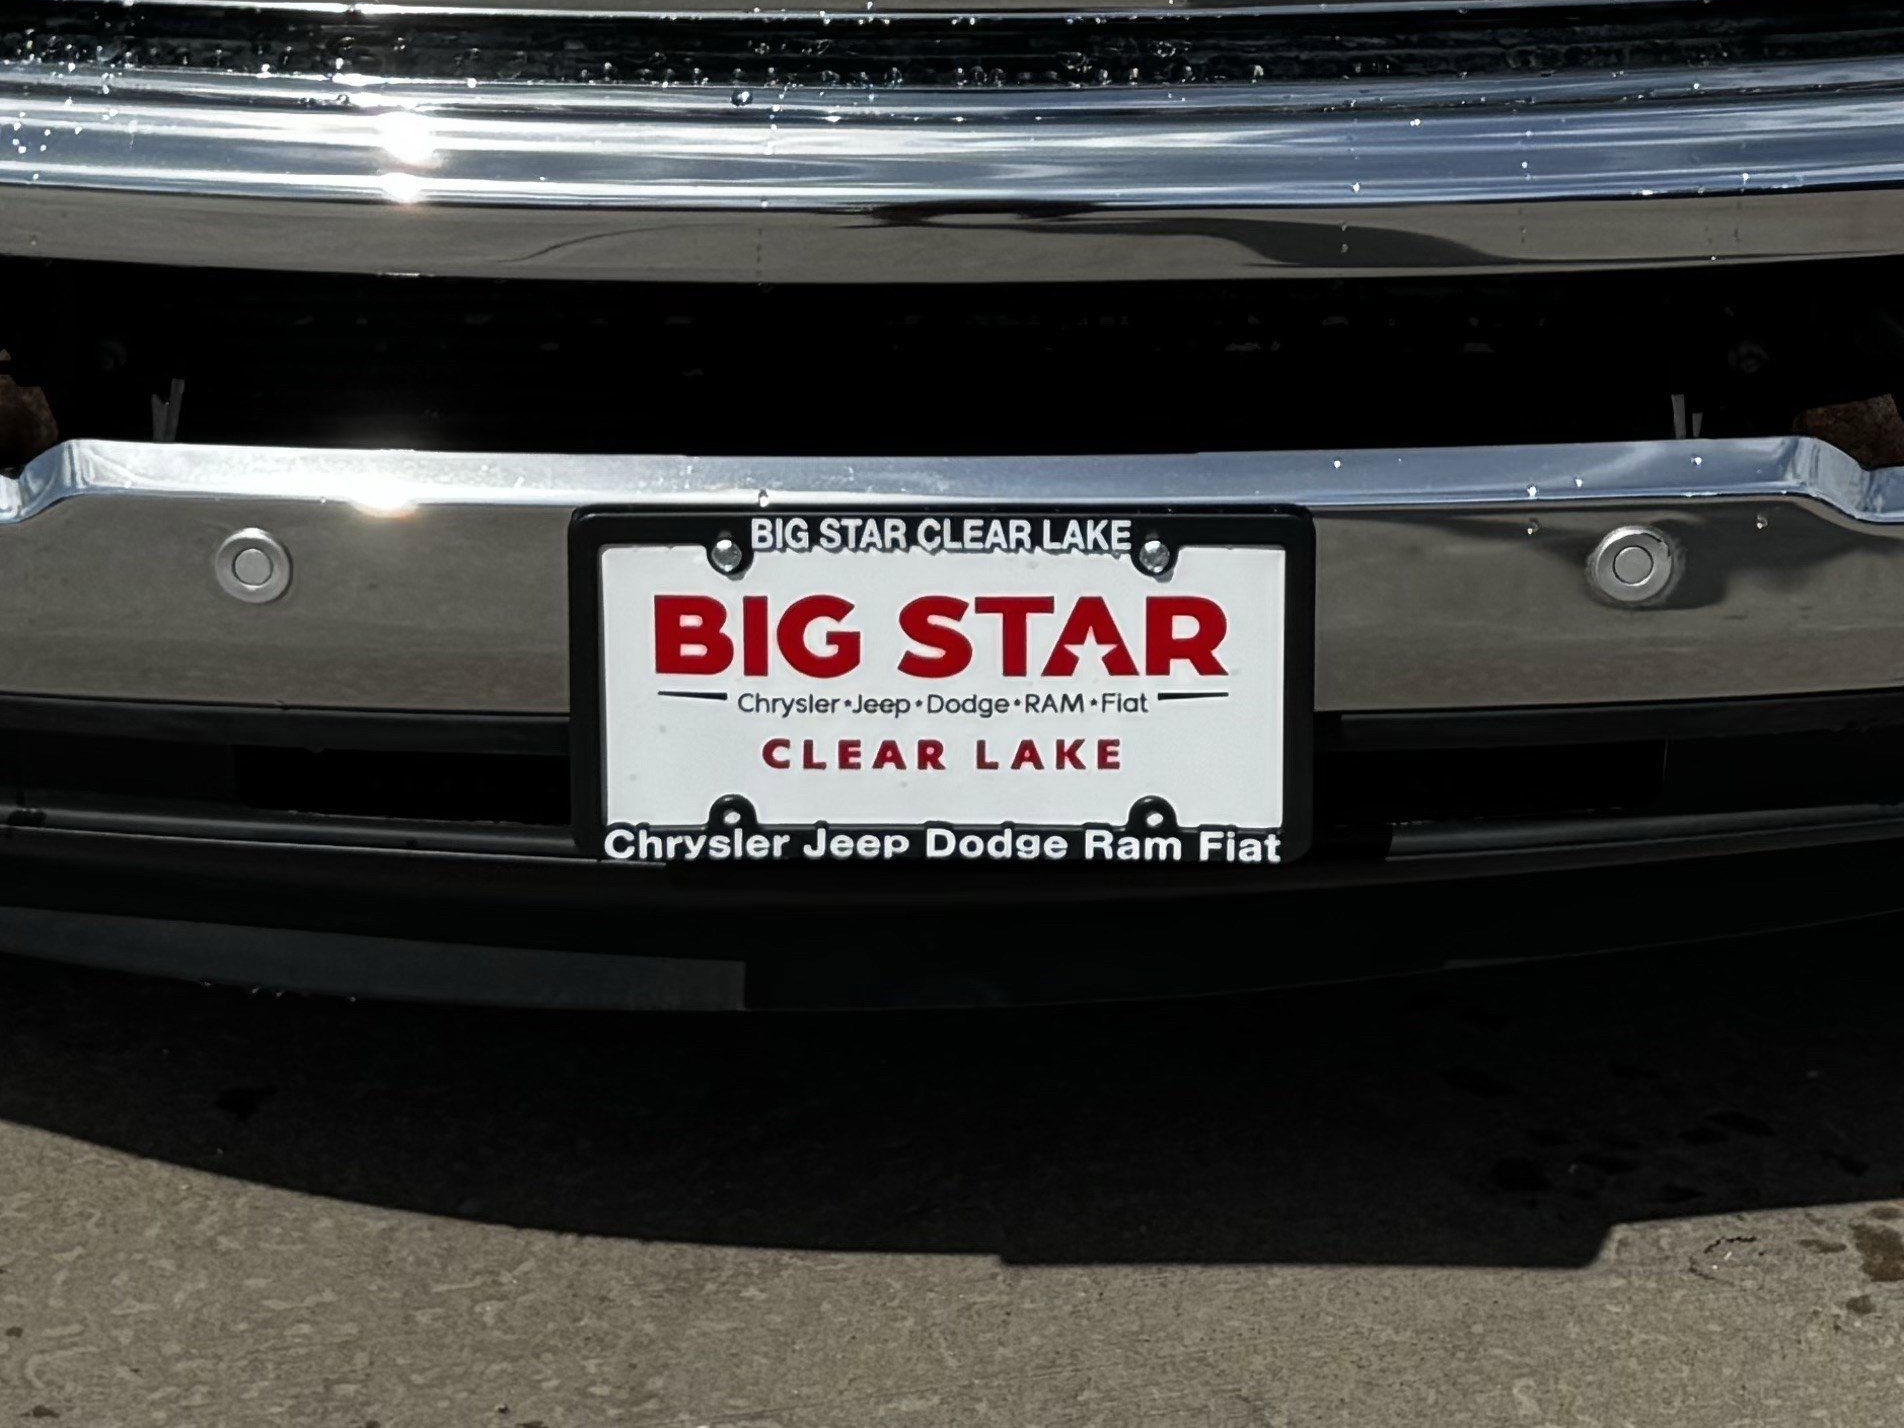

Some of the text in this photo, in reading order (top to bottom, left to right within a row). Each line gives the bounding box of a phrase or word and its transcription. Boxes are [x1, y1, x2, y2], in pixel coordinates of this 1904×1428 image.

[751, 517, 1132, 552] BIG STAR CLEAR LAKE
[654, 594, 1229, 678] BIG STAR
[737, 692, 1149, 719] Chrysler Jeep Dodge RAM Fiat
[761, 737, 1121, 771] CLEAR LAKE
[603, 827, 1283, 863] Chrysler Jeep Dodge Ram Fiat
